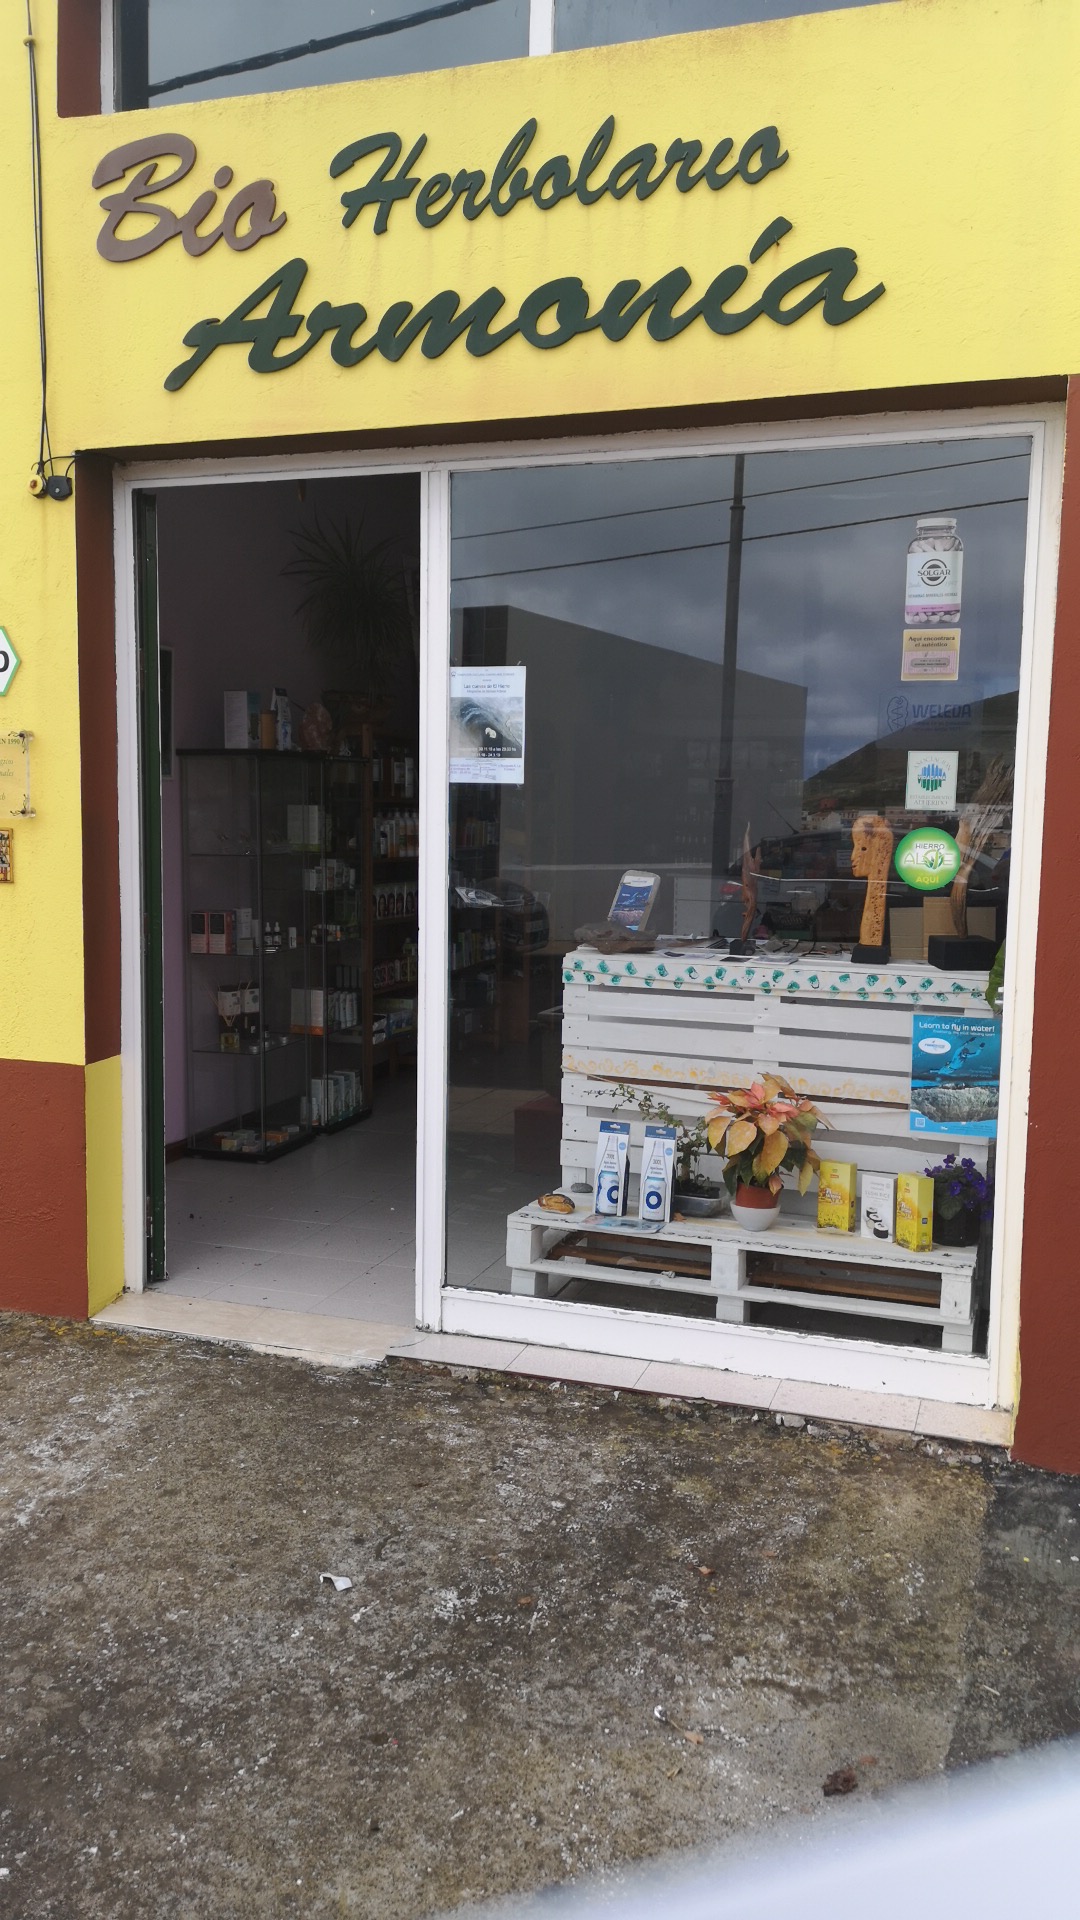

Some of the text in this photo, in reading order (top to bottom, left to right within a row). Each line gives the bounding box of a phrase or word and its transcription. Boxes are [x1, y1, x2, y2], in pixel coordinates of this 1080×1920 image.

[91, 115, 790, 263] Bio Herbolario
[163, 216, 886, 393] Armonía
[917, 569, 951, 577] SOLGAR
[912, 704, 971, 719] WELEDA
[919, 1021, 940, 1029] Learn
[951, 1023, 961, 1031] fly
[970, 1025, 995, 1033] water!
